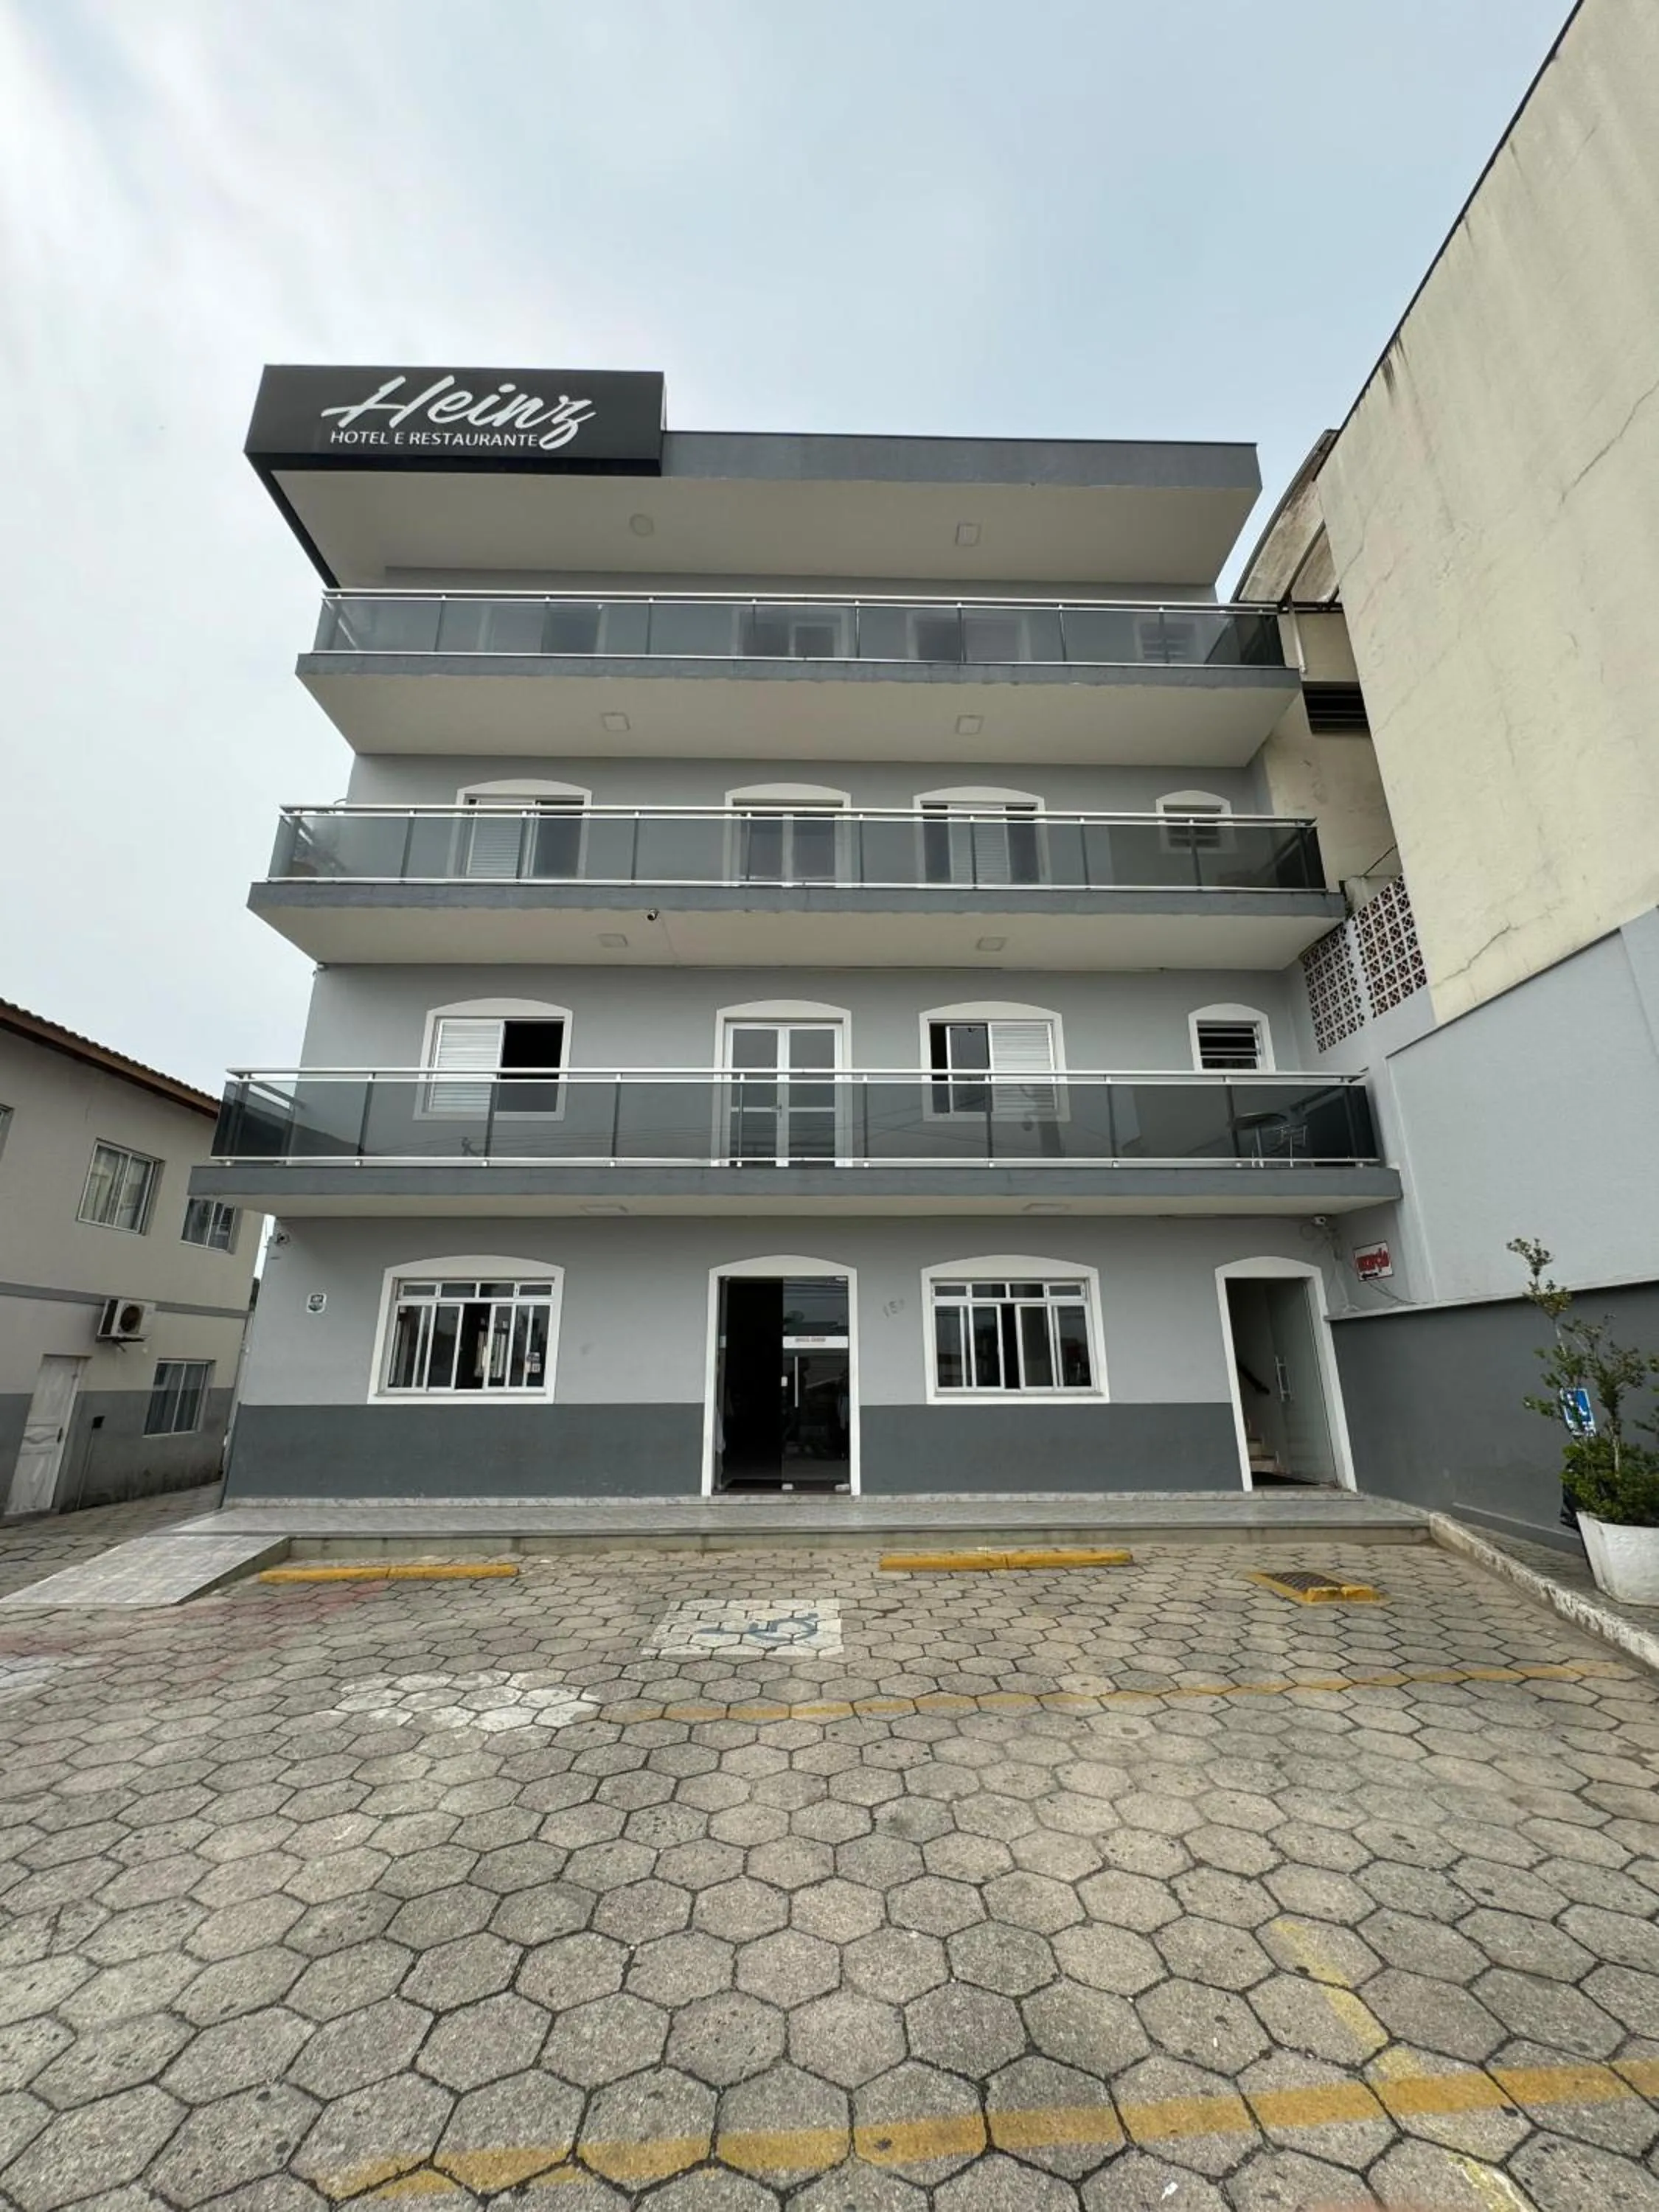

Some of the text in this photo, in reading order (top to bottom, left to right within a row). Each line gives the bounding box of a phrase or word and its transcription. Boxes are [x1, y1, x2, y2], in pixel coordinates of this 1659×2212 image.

[320, 374, 597, 450] Heinz
[330, 431, 538, 447] HOTEL E RESTAURANTE
